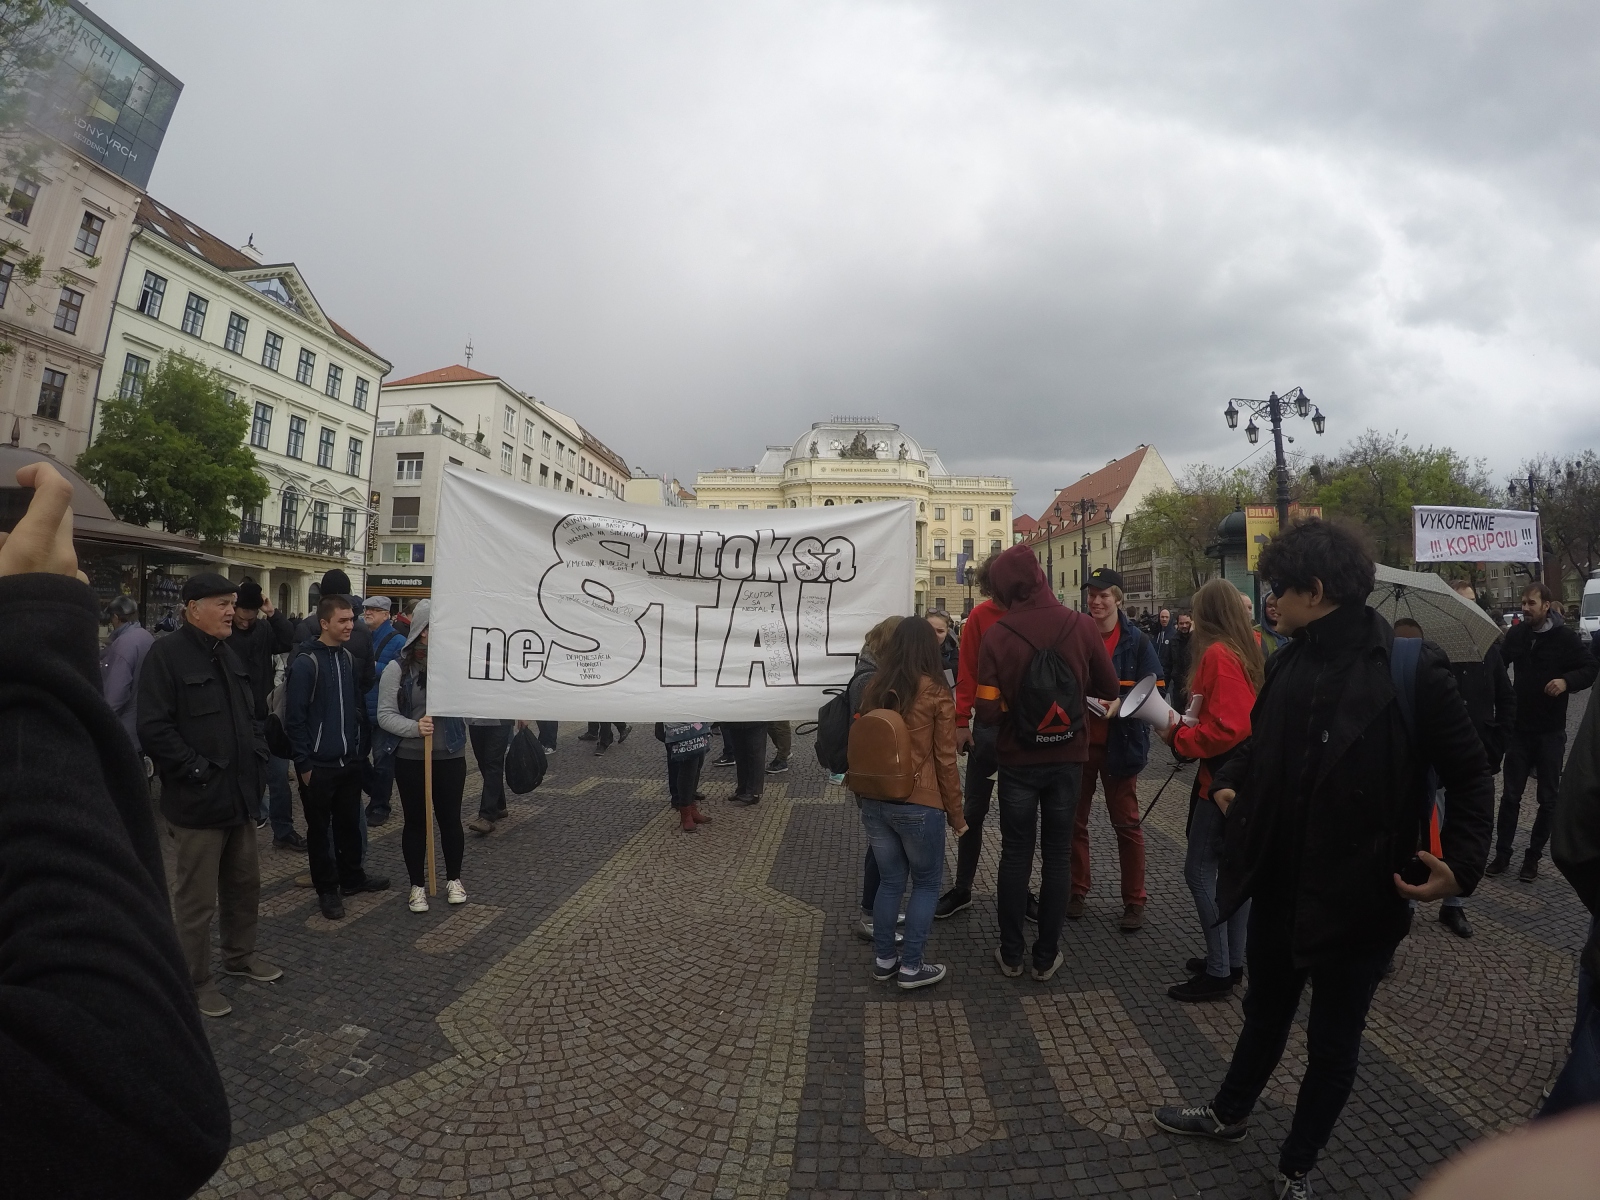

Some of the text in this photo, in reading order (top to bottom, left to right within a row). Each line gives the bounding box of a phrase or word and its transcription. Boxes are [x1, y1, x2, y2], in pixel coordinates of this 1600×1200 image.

[105, 135, 138, 162] VRCH
[1249, 509, 1273, 517] BILLA
[1420, 512, 1495, 531] VYKOREŇME
[1446, 529, 1518, 556] KORUPCIU
[792, 535, 857, 583] sa
[742, 590, 773, 601] SKUTOK
[1035, 731, 1074, 743] Reebok
